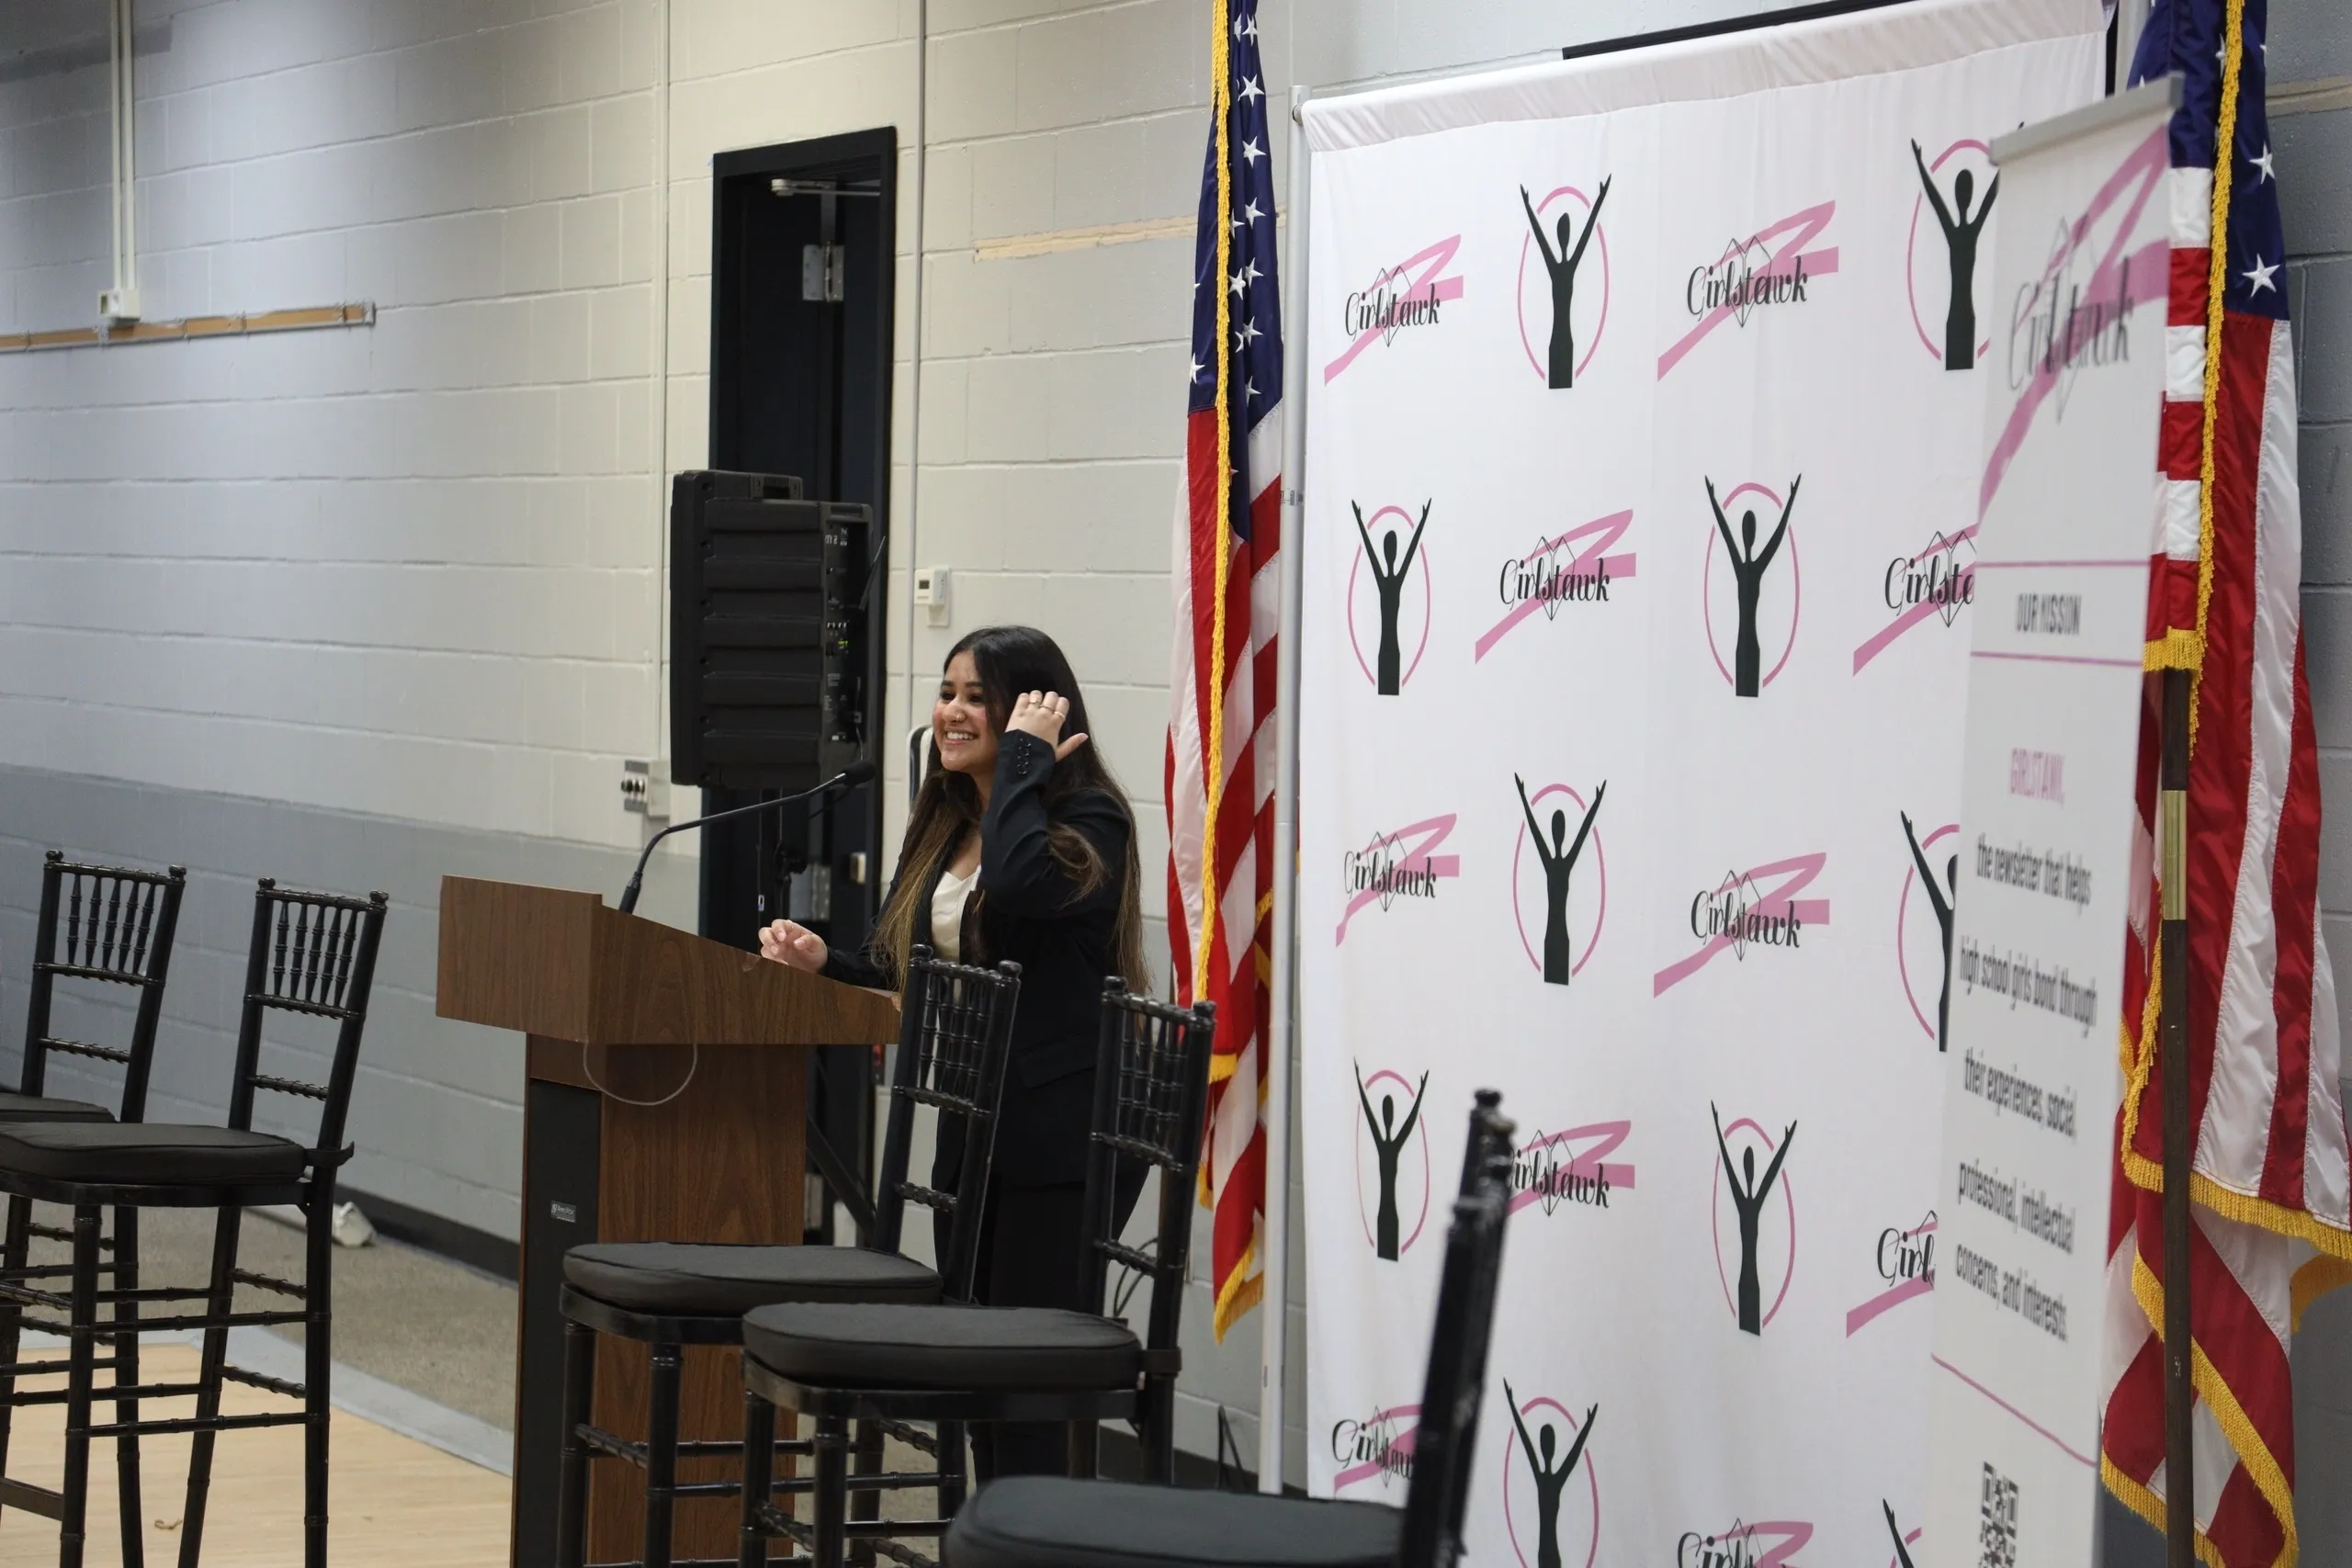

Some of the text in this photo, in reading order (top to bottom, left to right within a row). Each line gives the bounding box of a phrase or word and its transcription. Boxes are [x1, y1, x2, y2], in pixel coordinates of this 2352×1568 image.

[1345, 283, 1441, 343] Girlstawk
[1687, 255, 1809, 321] Girlstawk
[1499, 557, 1611, 611] Girlstawk
[1344, 851, 1437, 899] Girlstawk
[1691, 890, 1801, 948] Girlstawk
[1510, 1149, 1610, 1208] irlstawk
